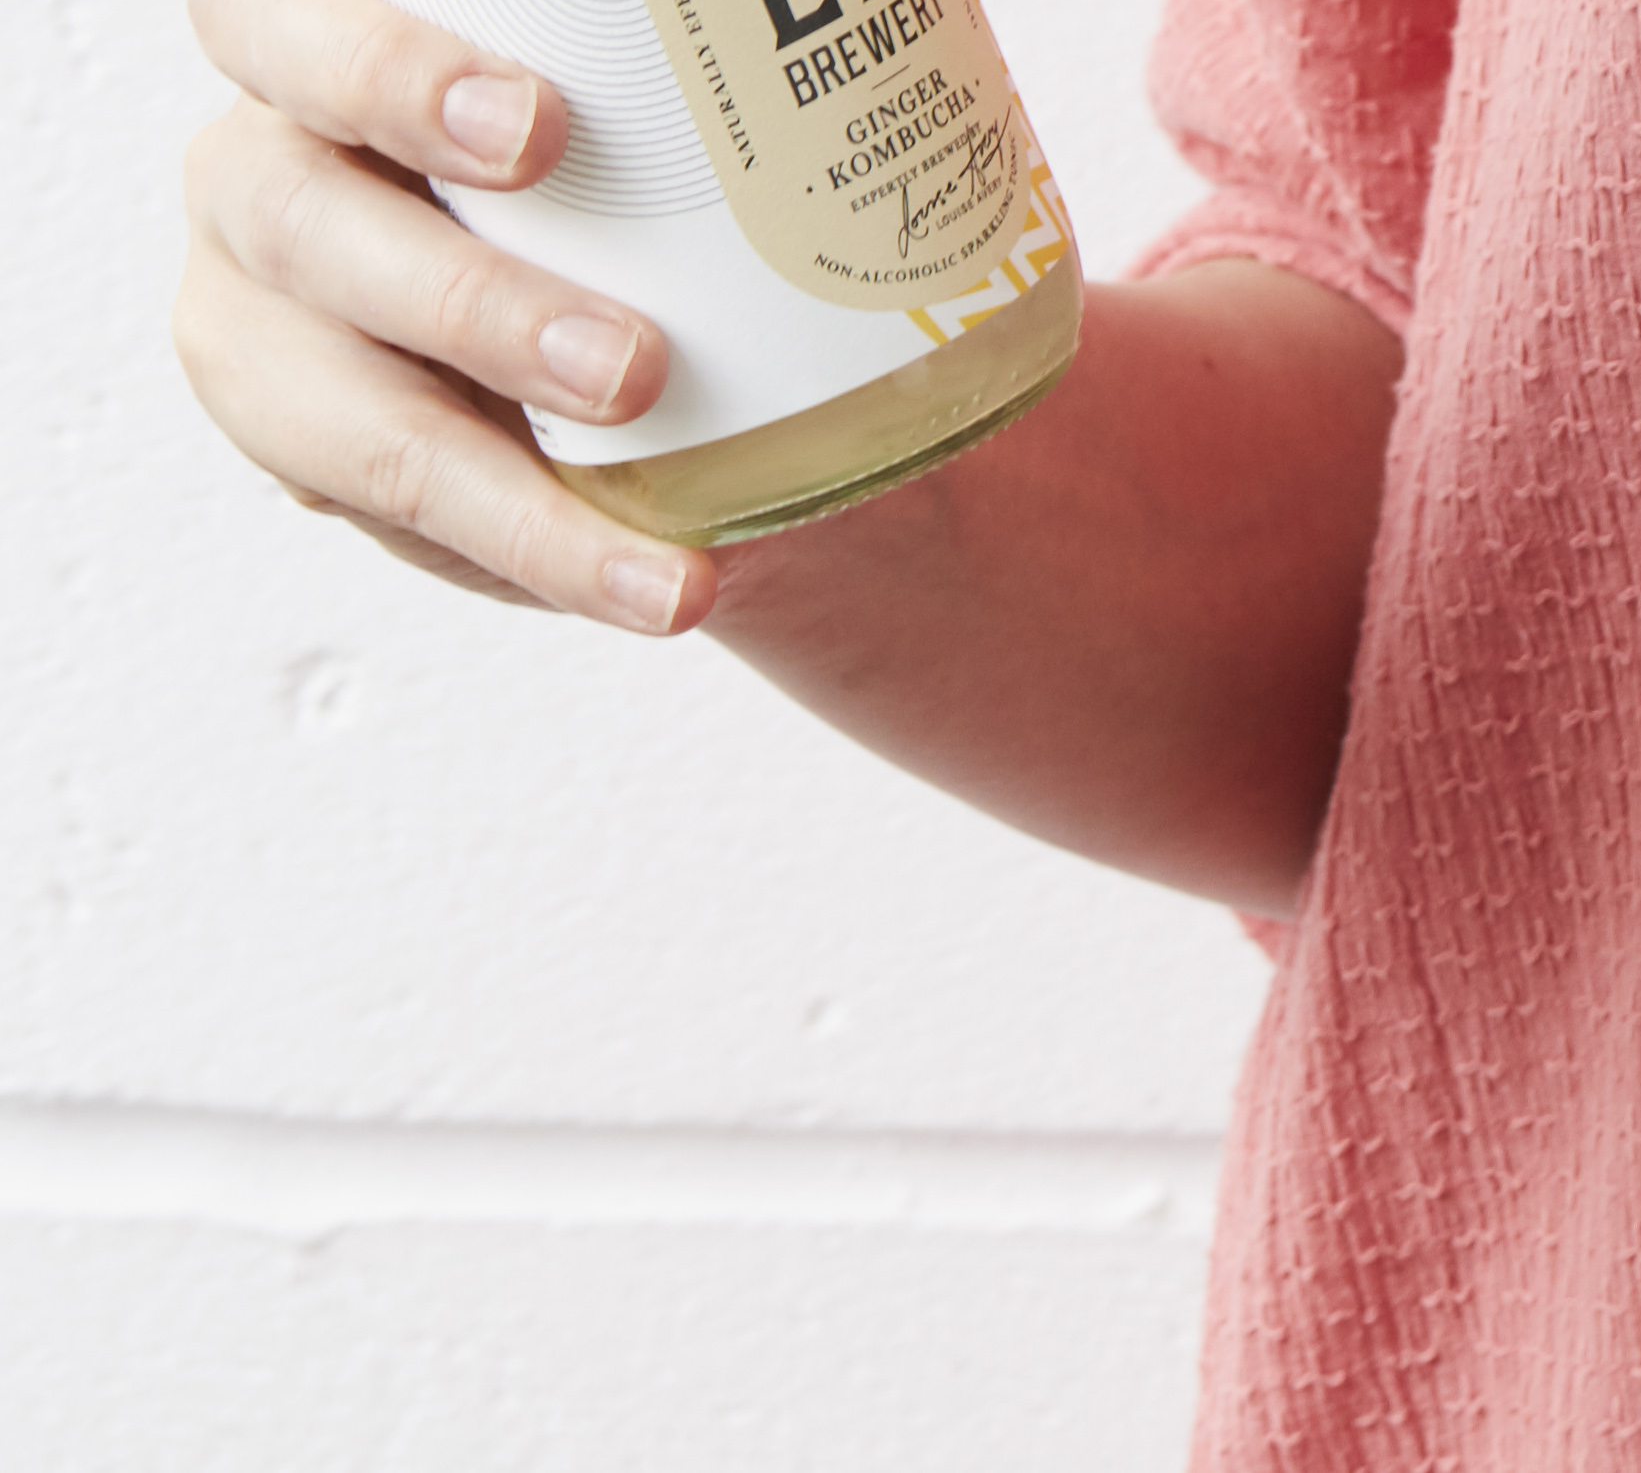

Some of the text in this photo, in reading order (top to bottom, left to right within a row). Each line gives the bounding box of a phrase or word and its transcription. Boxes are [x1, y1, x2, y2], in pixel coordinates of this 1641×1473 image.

[695, 42, 759, 172] NATURALLY
[845, 67, 949, 145] GINGER
[850, 165, 918, 214] EXPERTLY
[920, 132, 968, 173] BREWED
[814, 251, 958, 284] NON-ALCOHOLIC
[960, 187, 1014, 260] SPARKLING
[935, 198, 974, 231] LOUISE
